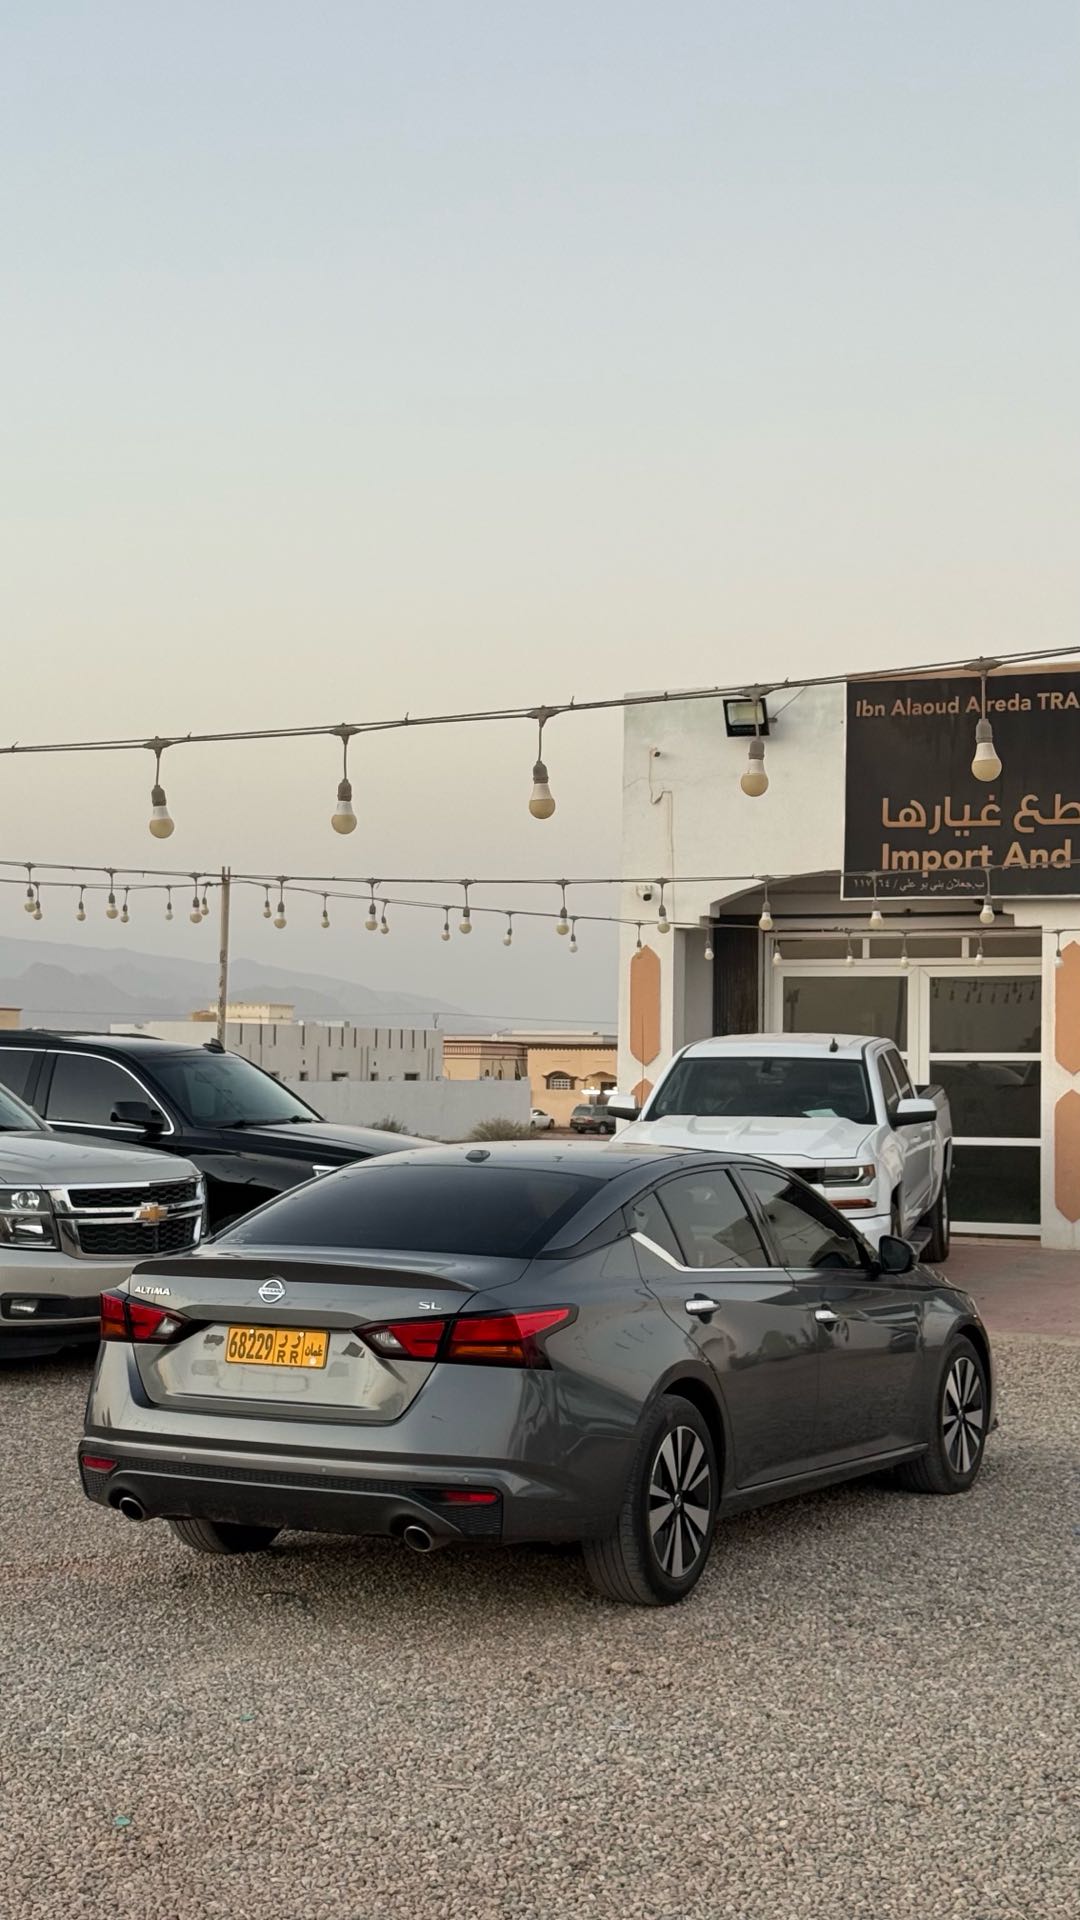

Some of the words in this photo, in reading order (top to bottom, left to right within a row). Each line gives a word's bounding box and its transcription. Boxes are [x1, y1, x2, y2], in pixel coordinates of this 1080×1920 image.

[855, 699, 885, 718] Ibn
[890, 696, 960, 716] Alaoud
[965, 693, 1032, 713] Areda
[1036, 691, 1080, 710] TRA
[882, 794, 1001, 837] غيارها
[881, 843, 993, 878] Import
[1001, 838, 1072, 870] And
[134, 1286, 171, 1296] ALTIMA
[418, 1301, 442, 1310] SL
[228, 1331, 274, 1361] 68229
